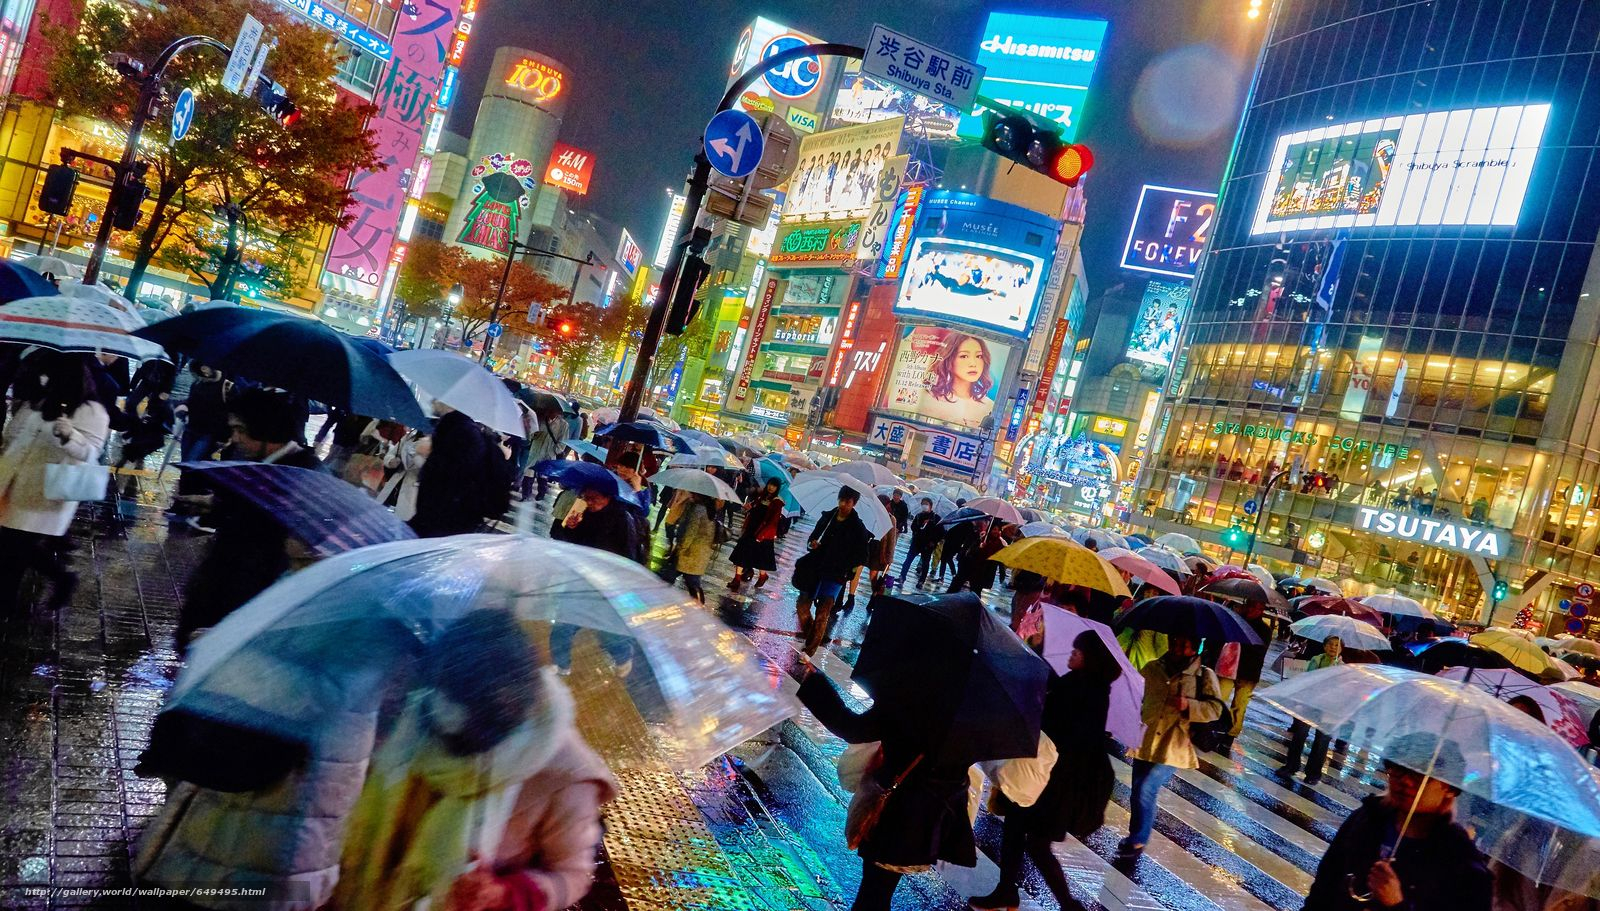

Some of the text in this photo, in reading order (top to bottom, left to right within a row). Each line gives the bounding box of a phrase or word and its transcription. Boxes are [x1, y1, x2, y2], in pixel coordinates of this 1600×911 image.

[311, 4, 389, 55] 英会話イーオン
[980, 35, 1095, 62] Hisamitsu
[522, 58, 562, 80] SHIBUYA
[876, 35, 974, 90] 渋谷駅前
[505, 64, 561, 101] 109
[887, 64, 955, 100] Shibuya Sta.
[741, 95, 775, 112] MasterCard
[791, 113, 815, 129] VISA
[557, 150, 587, 171] H&M
[562, 176, 583, 189] 150m
[862, 166, 900, 256] もんじゃ
[962, 222, 999, 233] MUSÉE
[800, 235, 828, 252] 西村
[1035, 293, 1055, 334] neon
[775, 329, 816, 342] Euphoria
[899, 350, 943, 366] 西野カナ
[896, 370, 911, 378] with
[1035, 376, 1052, 409] 三千里
[1214, 421, 1410, 460] STARBUCKS COFFEE
[1361, 508, 1499, 556] TSUTAYA
